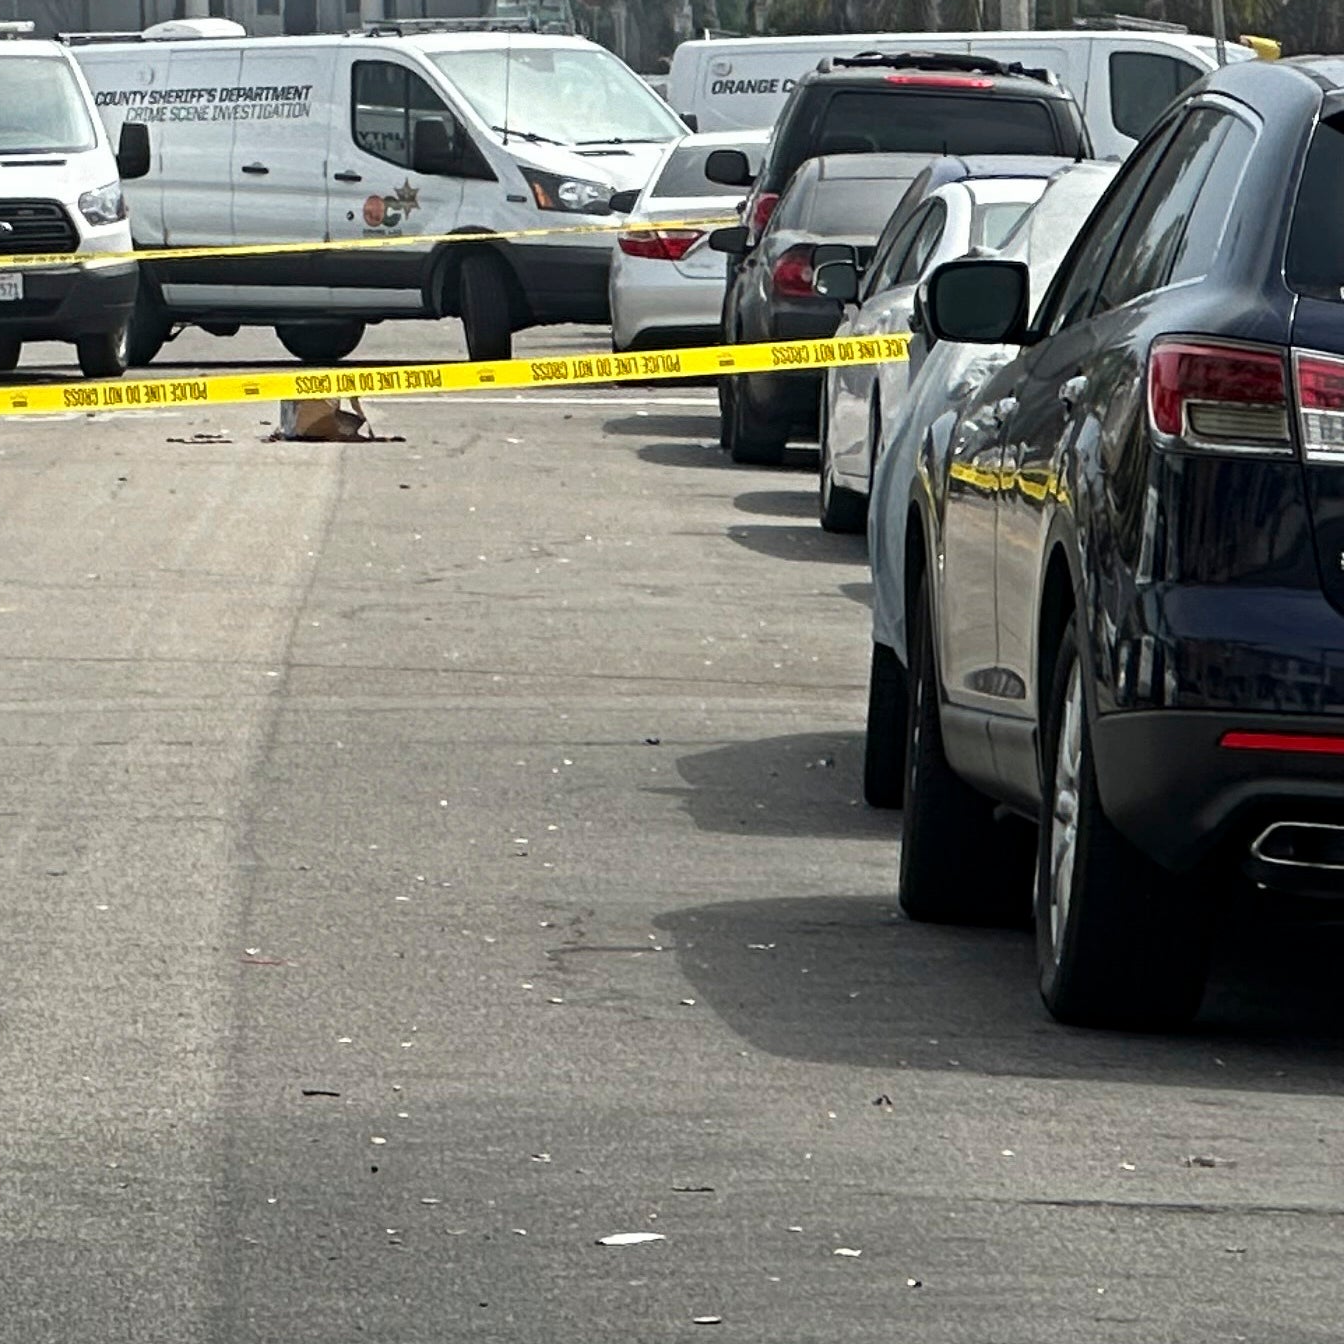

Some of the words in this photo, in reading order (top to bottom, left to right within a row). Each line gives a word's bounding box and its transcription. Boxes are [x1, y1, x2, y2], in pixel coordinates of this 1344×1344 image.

[95, 90, 147, 106] COUNTY
[148, 88, 218, 105] SHERIFF'S
[219, 85, 312, 104] DEPARTMENT
[712, 79, 780, 95] ORANGE
[126, 106, 167, 123] CRIME
[169, 106, 209, 122] SCENE
[212, 102, 311, 122] INVESTIGATION
[772, 346, 808, 364] CROSS
[814, 343, 834, 361] NOT
[837, 342, 852, 360] DO
[857, 340, 879, 358] LINE
[531, 362, 567, 381] CROSS
[573, 360, 593, 379] NOT
[597, 358, 611, 377] DO
[616, 356, 638, 375] LINE
[643, 354, 680, 373] POLICE
[296, 375, 331, 394] CROSS
[337, 373, 355, 392] NOT
[360, 372, 373, 391] DO
[379, 371, 400, 389] LINE
[406, 369, 441, 387] POLICE
[64, 388, 98, 407] CROSS
[103, 386, 122, 405] NOT
[127, 385, 140, 404] DO
[145, 384, 166, 402] LINE
[172, 382, 207, 400] POLICE
